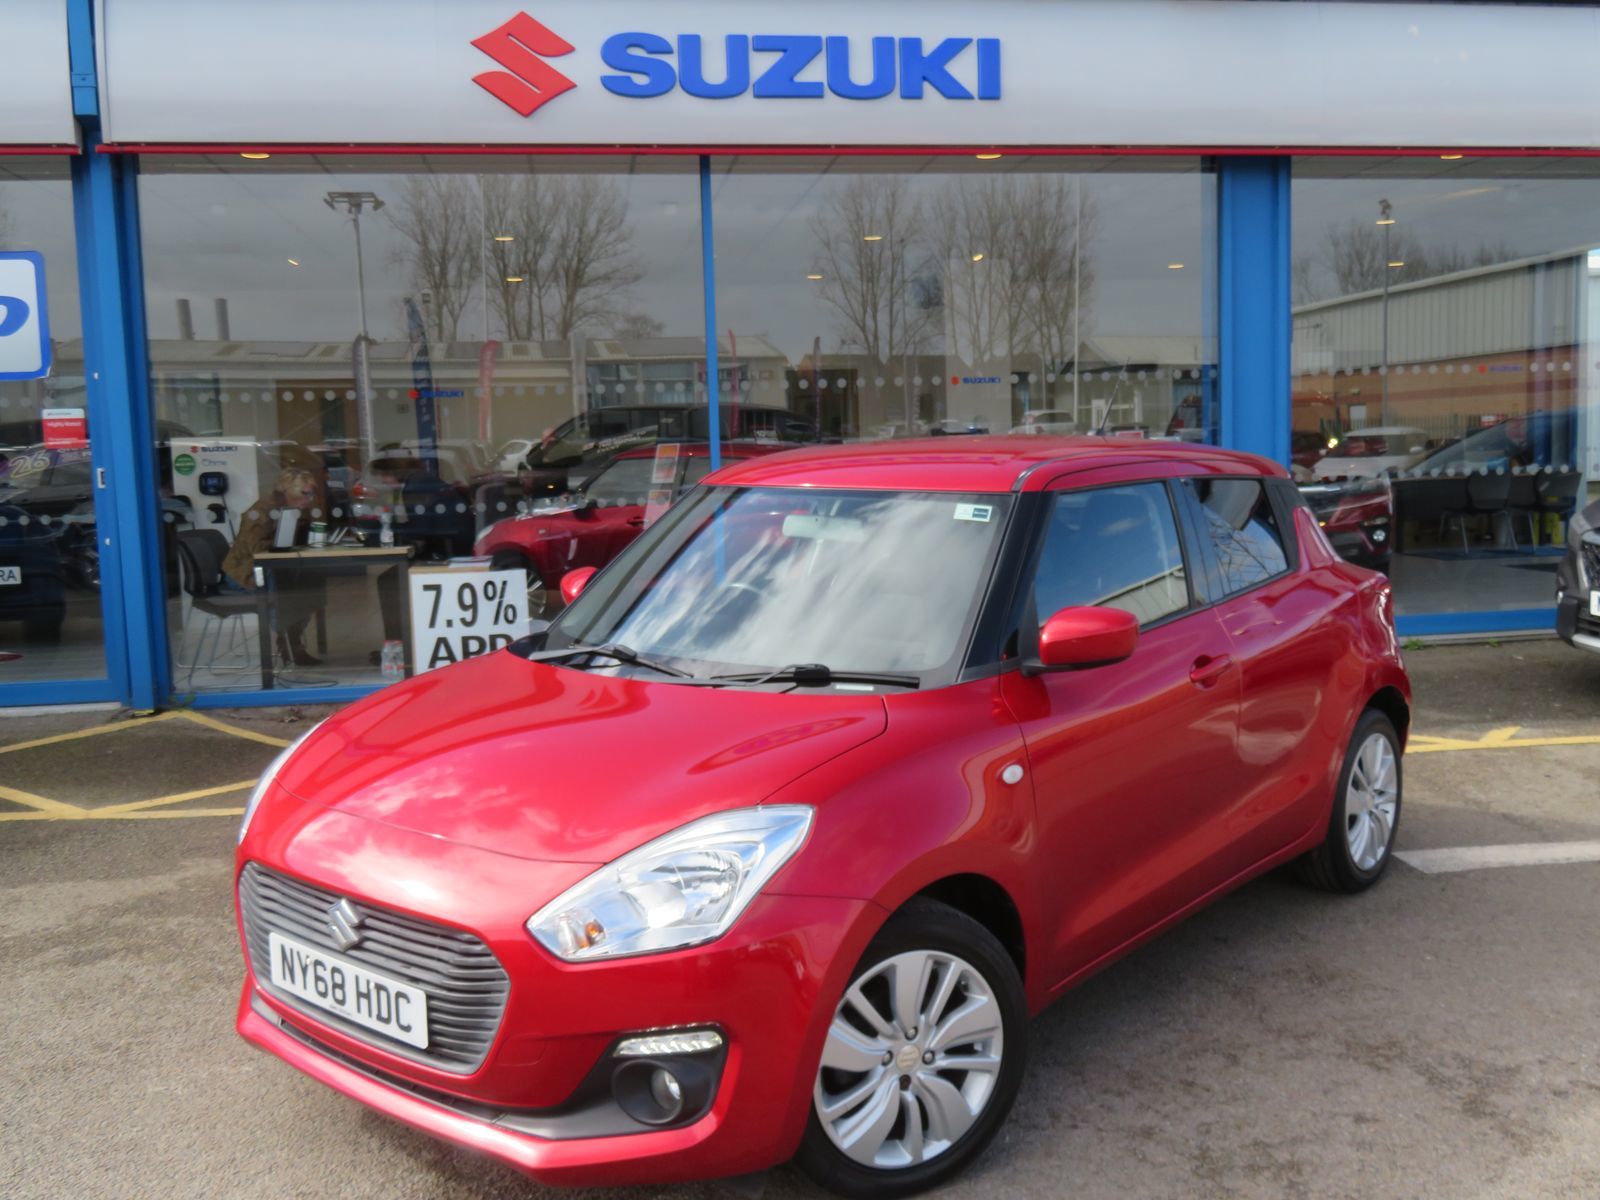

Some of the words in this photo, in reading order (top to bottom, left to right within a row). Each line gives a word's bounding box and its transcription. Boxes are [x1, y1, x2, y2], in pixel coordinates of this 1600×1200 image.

[600, 32, 1001, 100] SUZUKI
[420, 389, 465, 398] SUZUKI
[962, 376, 1001, 384] SUZUKI
[422, 580, 518, 629] 7.9%
[280, 943, 347, 1007] NY68
[355, 974, 413, 1033] HDC
